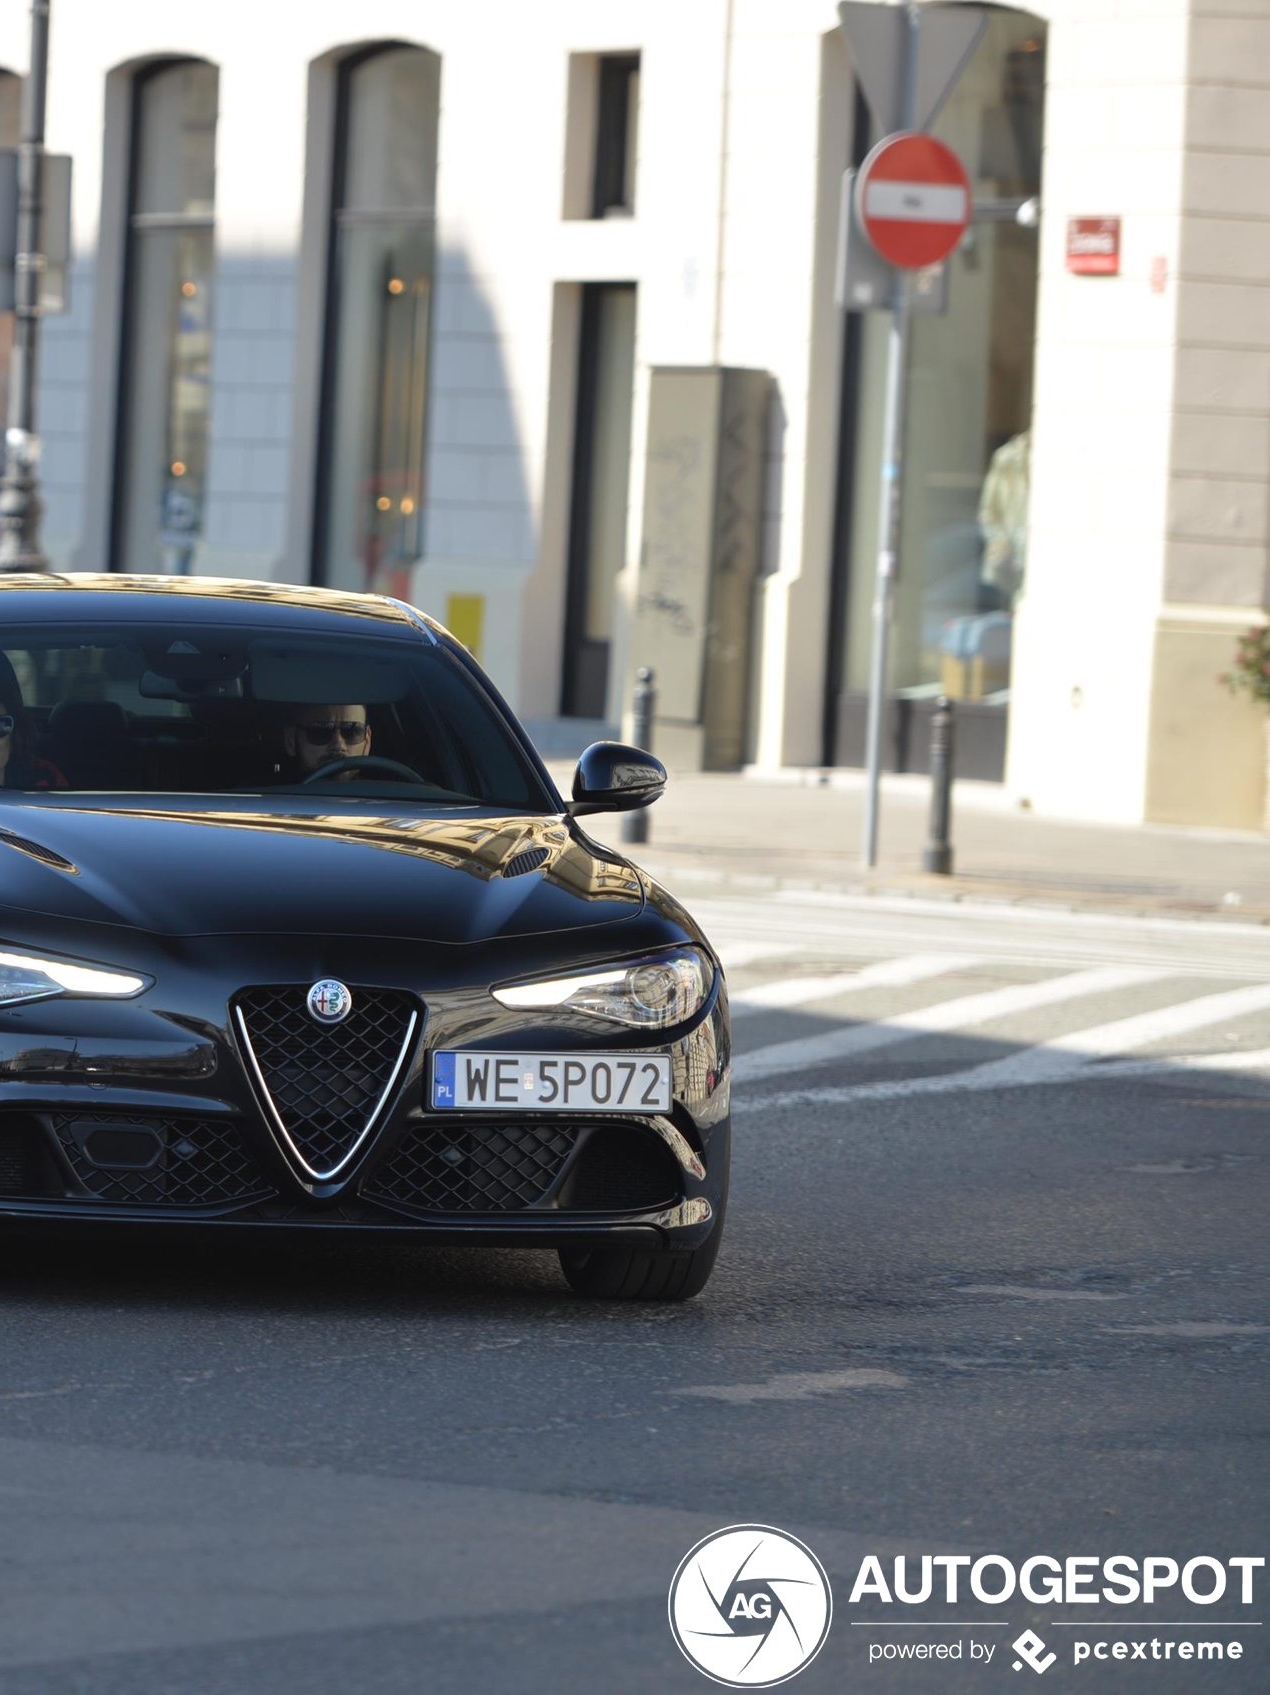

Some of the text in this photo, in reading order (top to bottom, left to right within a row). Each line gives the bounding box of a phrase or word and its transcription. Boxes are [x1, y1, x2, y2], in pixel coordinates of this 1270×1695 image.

[437, 1085, 453, 1098] PL
[466, 1058, 661, 1106] WE 5P072
